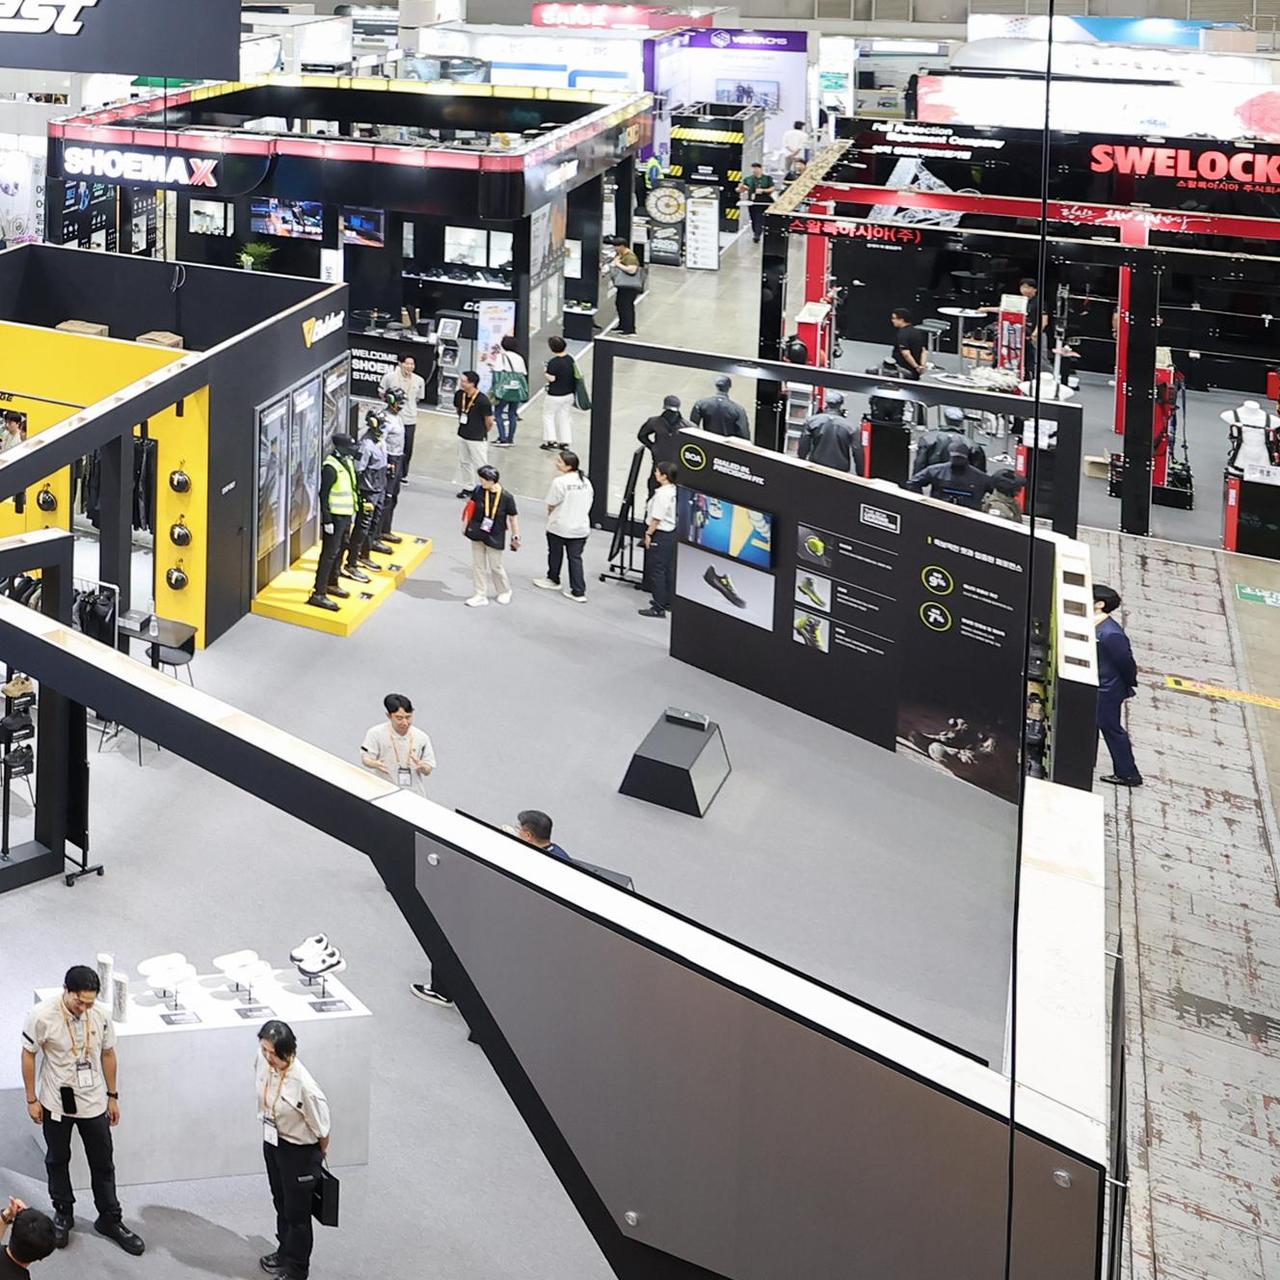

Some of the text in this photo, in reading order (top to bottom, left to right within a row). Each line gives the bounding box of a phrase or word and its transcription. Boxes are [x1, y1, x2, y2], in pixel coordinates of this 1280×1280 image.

[1090, 144, 1280, 184] SWELOCK
[351, 348, 398, 363] WELCOME
[351, 358, 402, 376] SHOEMA
[684, 451, 702, 464] BOA
